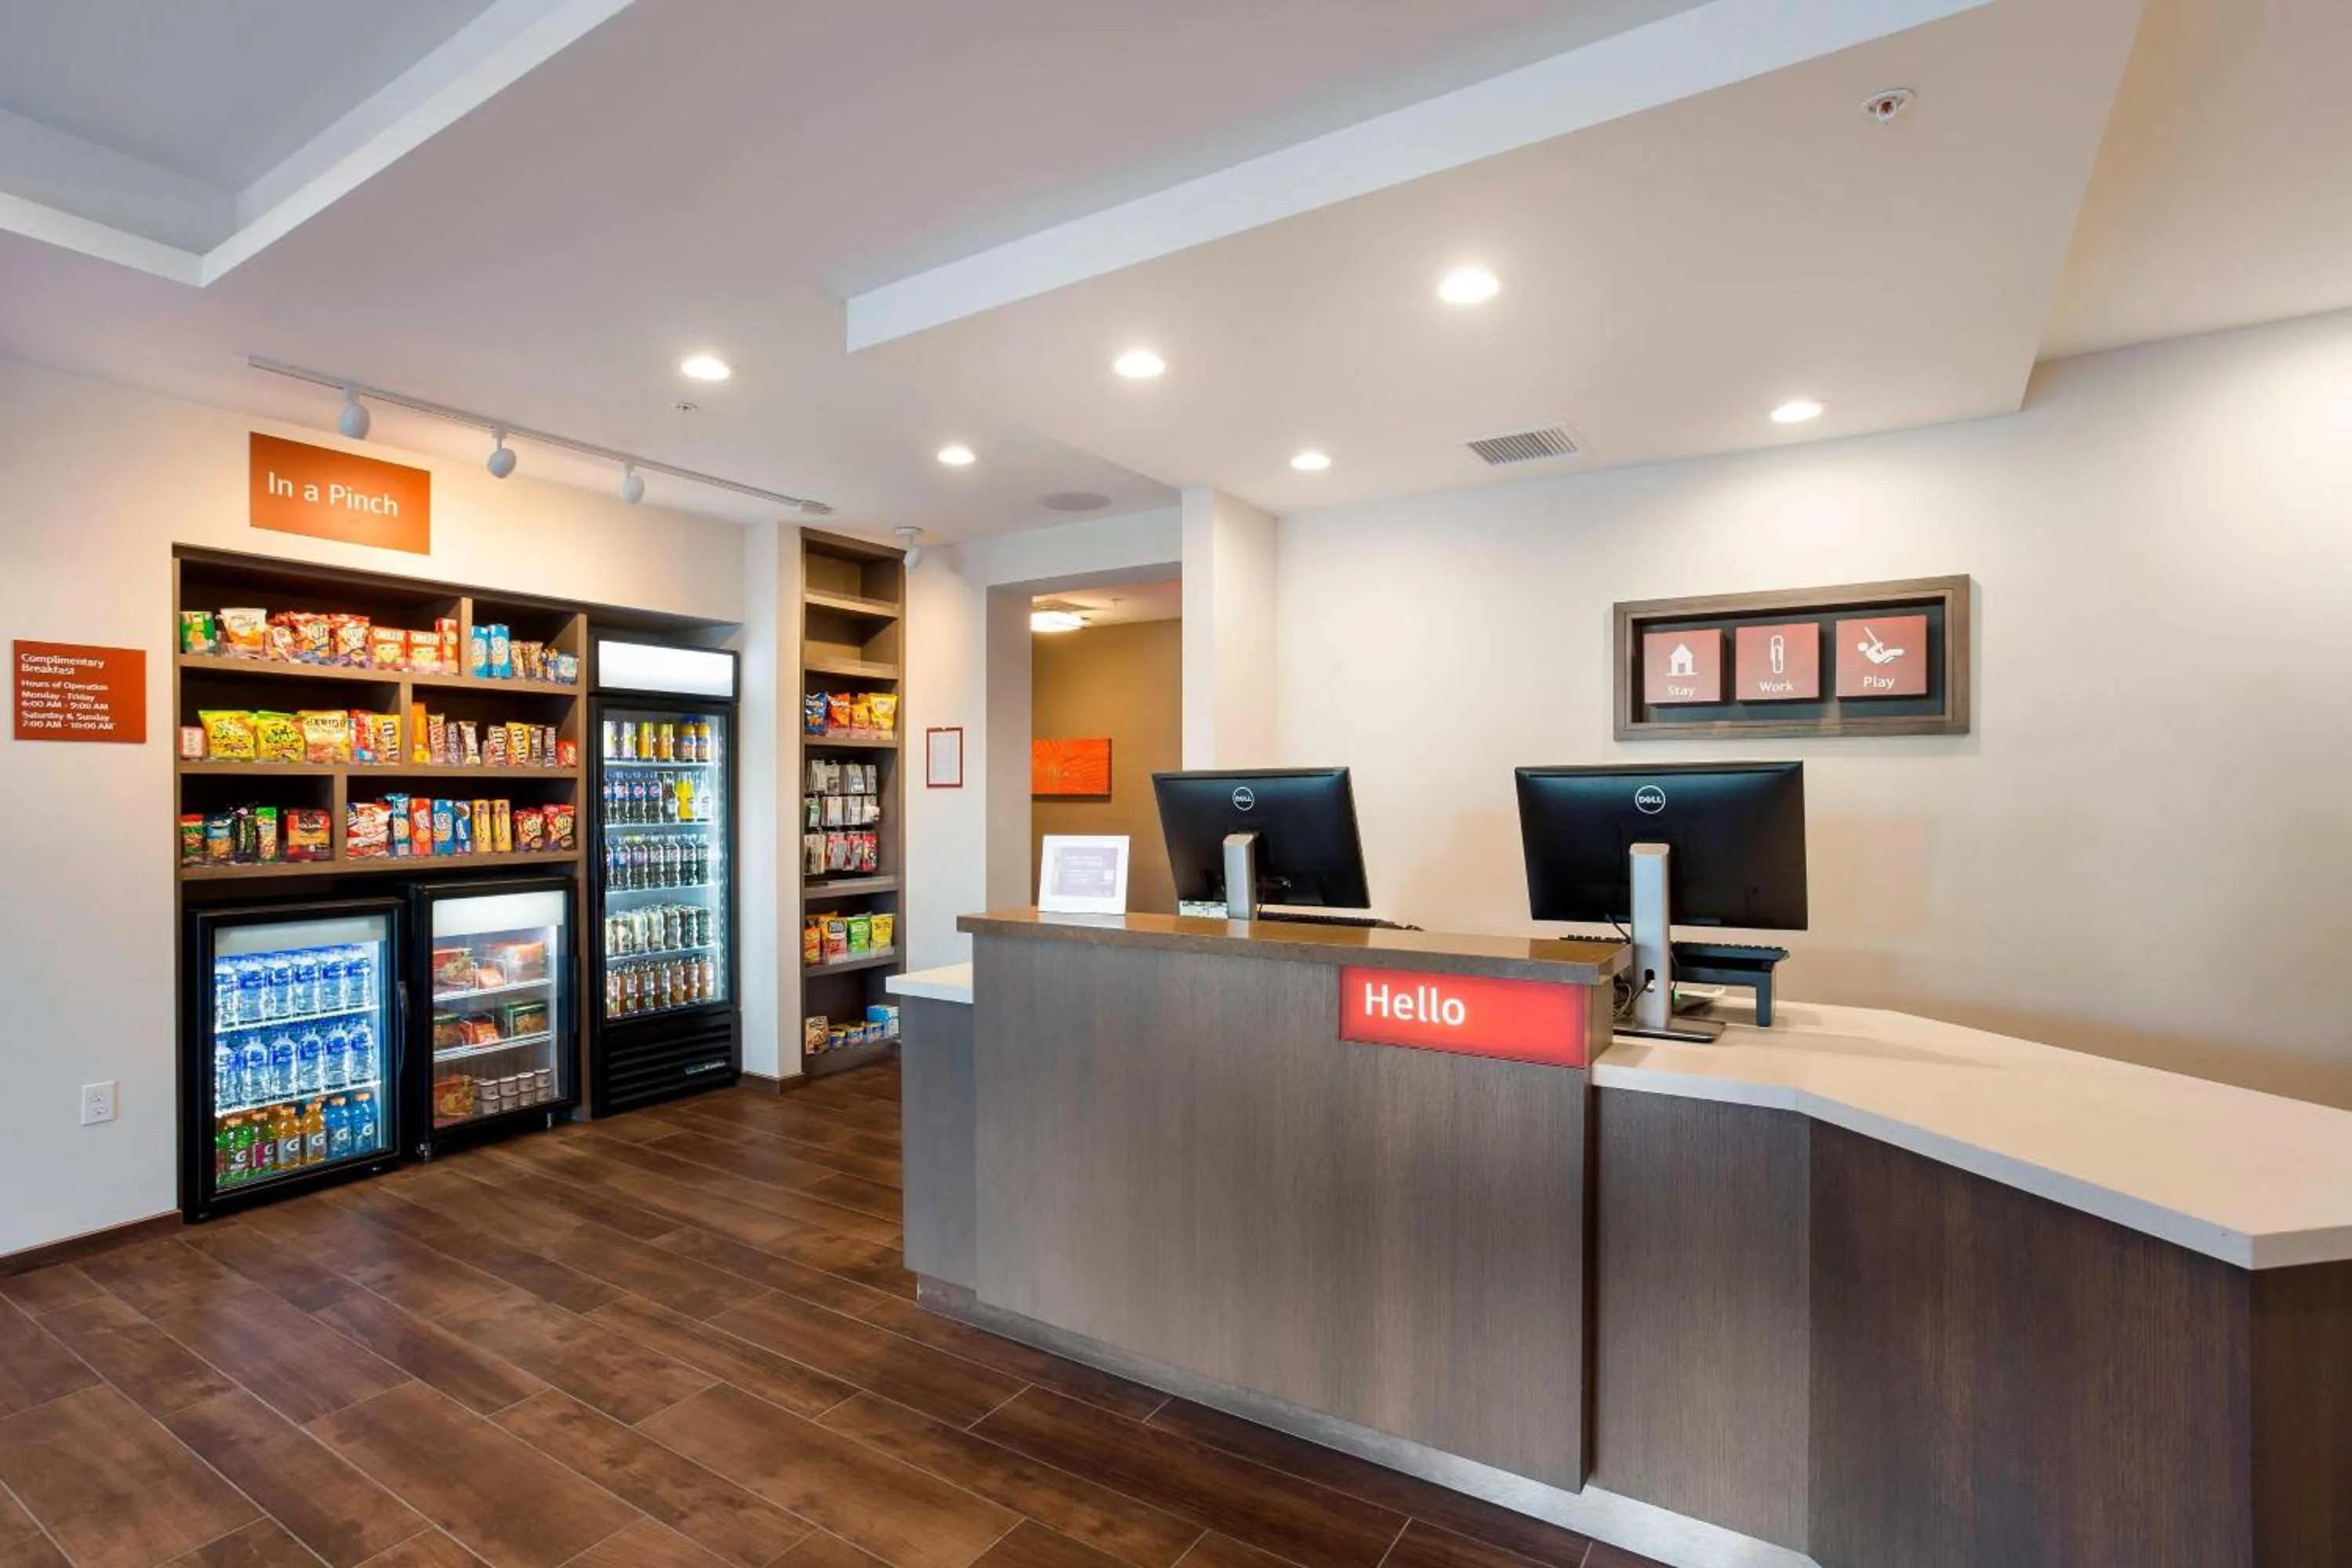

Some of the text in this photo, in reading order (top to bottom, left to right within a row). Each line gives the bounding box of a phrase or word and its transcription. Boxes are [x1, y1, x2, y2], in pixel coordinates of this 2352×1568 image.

[268, 471, 398, 517] In a Pinch
[21, 653, 105, 669] Complimentary
[21, 663, 75, 675] Breakfast
[21, 680, 109, 691] Hours of Operation
[1759, 681, 1794, 693] Work
[1863, 676, 1896, 690] Play
[21, 690, 60, 701] Monday
[67, 692, 95, 702] Friday
[1667, 684, 1696, 698] Stay
[45, 700, 62, 709] AM
[22, 710, 64, 721] Saturday
[76, 713, 110, 722] Sunday
[1365, 982, 1465, 1026] Hello
